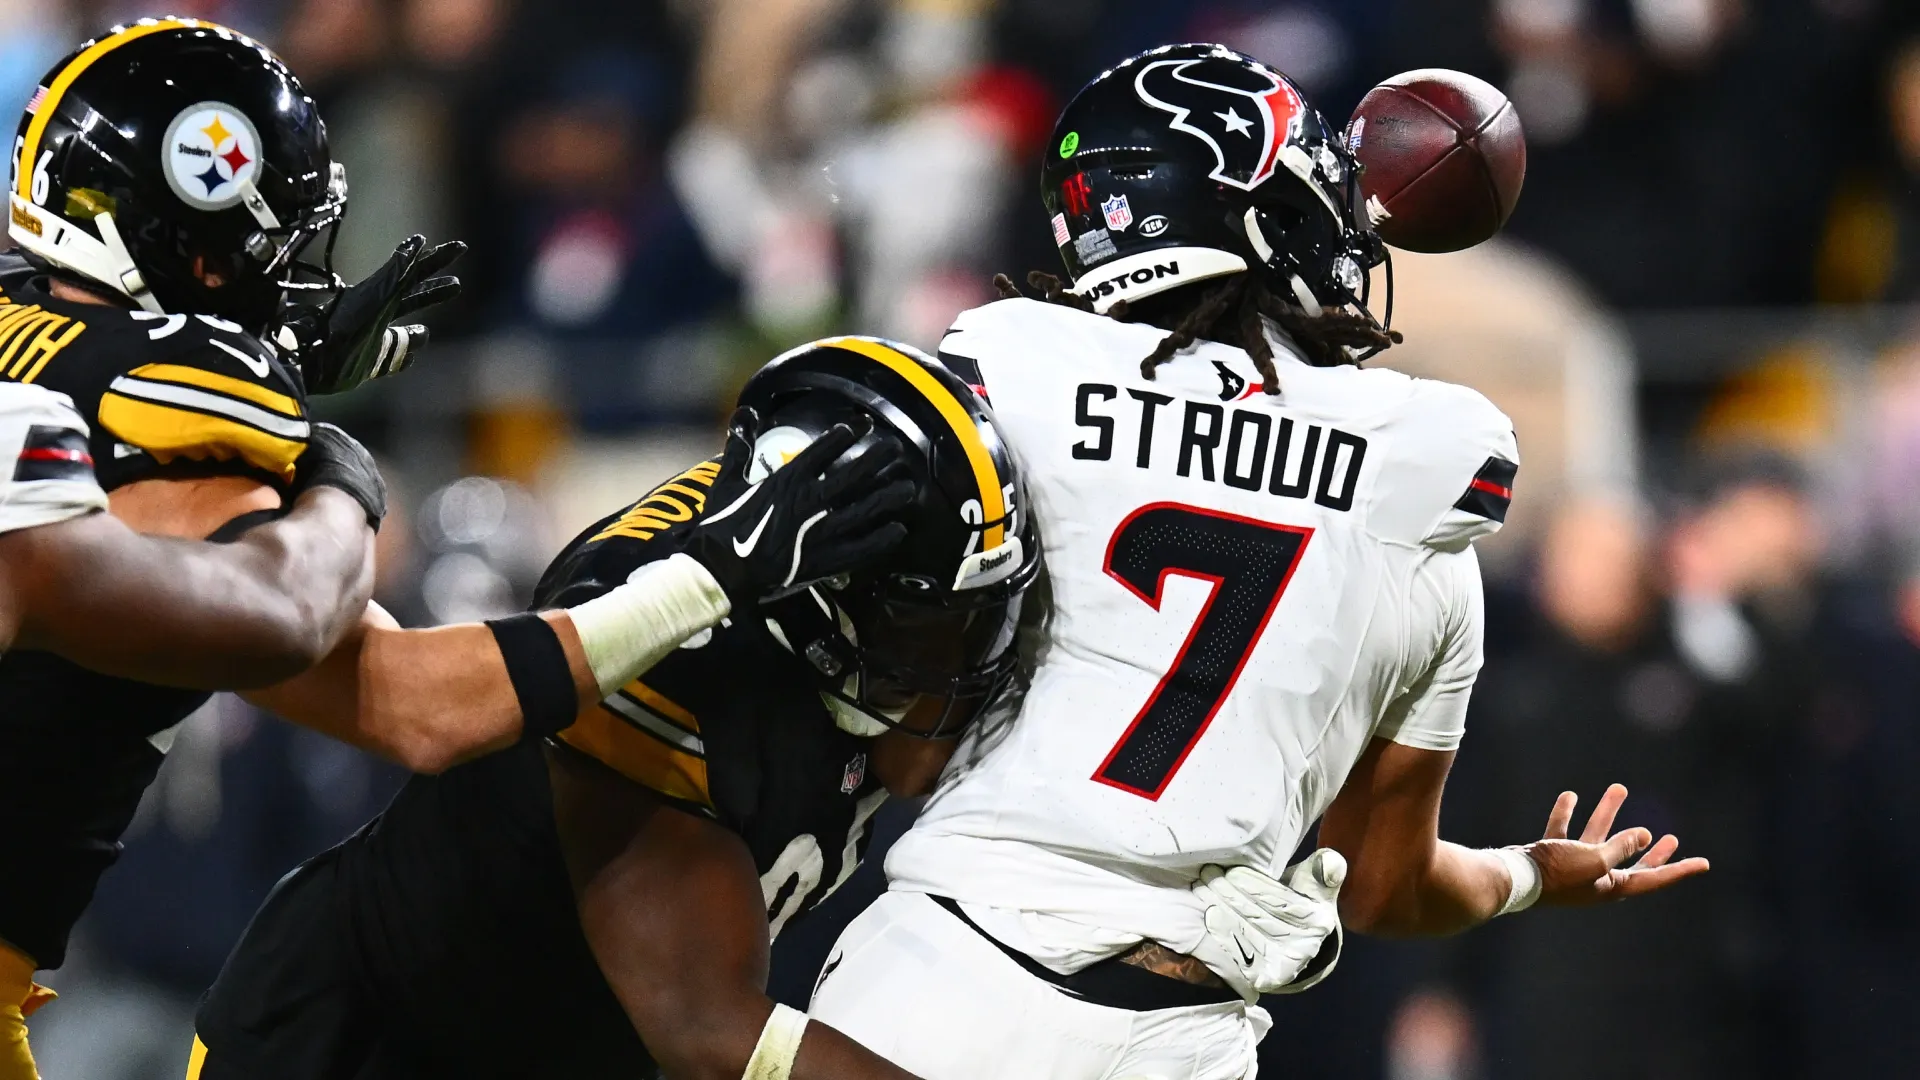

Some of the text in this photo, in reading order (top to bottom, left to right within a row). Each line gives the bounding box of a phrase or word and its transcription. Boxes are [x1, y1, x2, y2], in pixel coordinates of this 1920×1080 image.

[178, 142, 212, 158] Steelers
[12, 202, 43, 238] teelers
[1109, 210, 1129, 226] NFL
[1084, 261, 1180, 300] USTON
[1071, 383, 1368, 512] STROUD
[979, 550, 1013, 573] Steelers
[1090, 500, 1316, 802] 7
